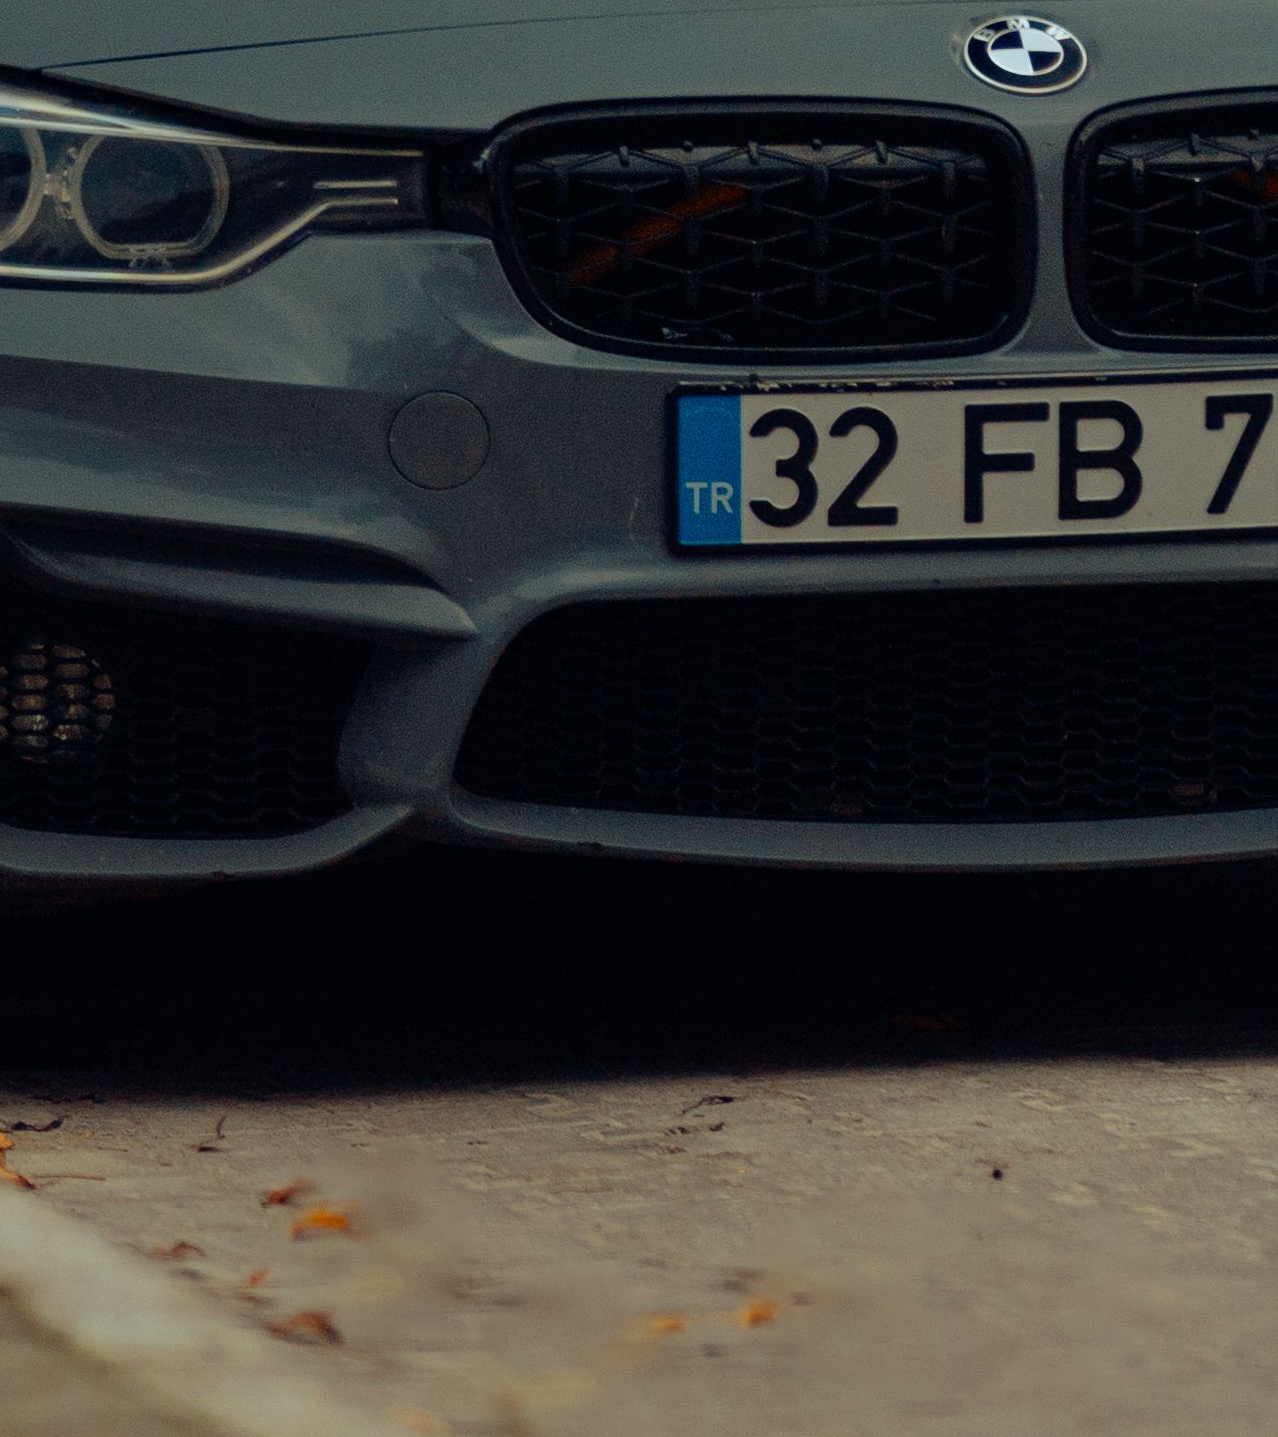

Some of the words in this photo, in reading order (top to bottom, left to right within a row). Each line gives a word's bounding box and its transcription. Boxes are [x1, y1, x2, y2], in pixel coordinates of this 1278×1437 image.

[973, 17, 1071, 42] BMW
[748, 407, 899, 528] 32
[962, 399, 1144, 523] FB
[685, 481, 735, 516] TR
